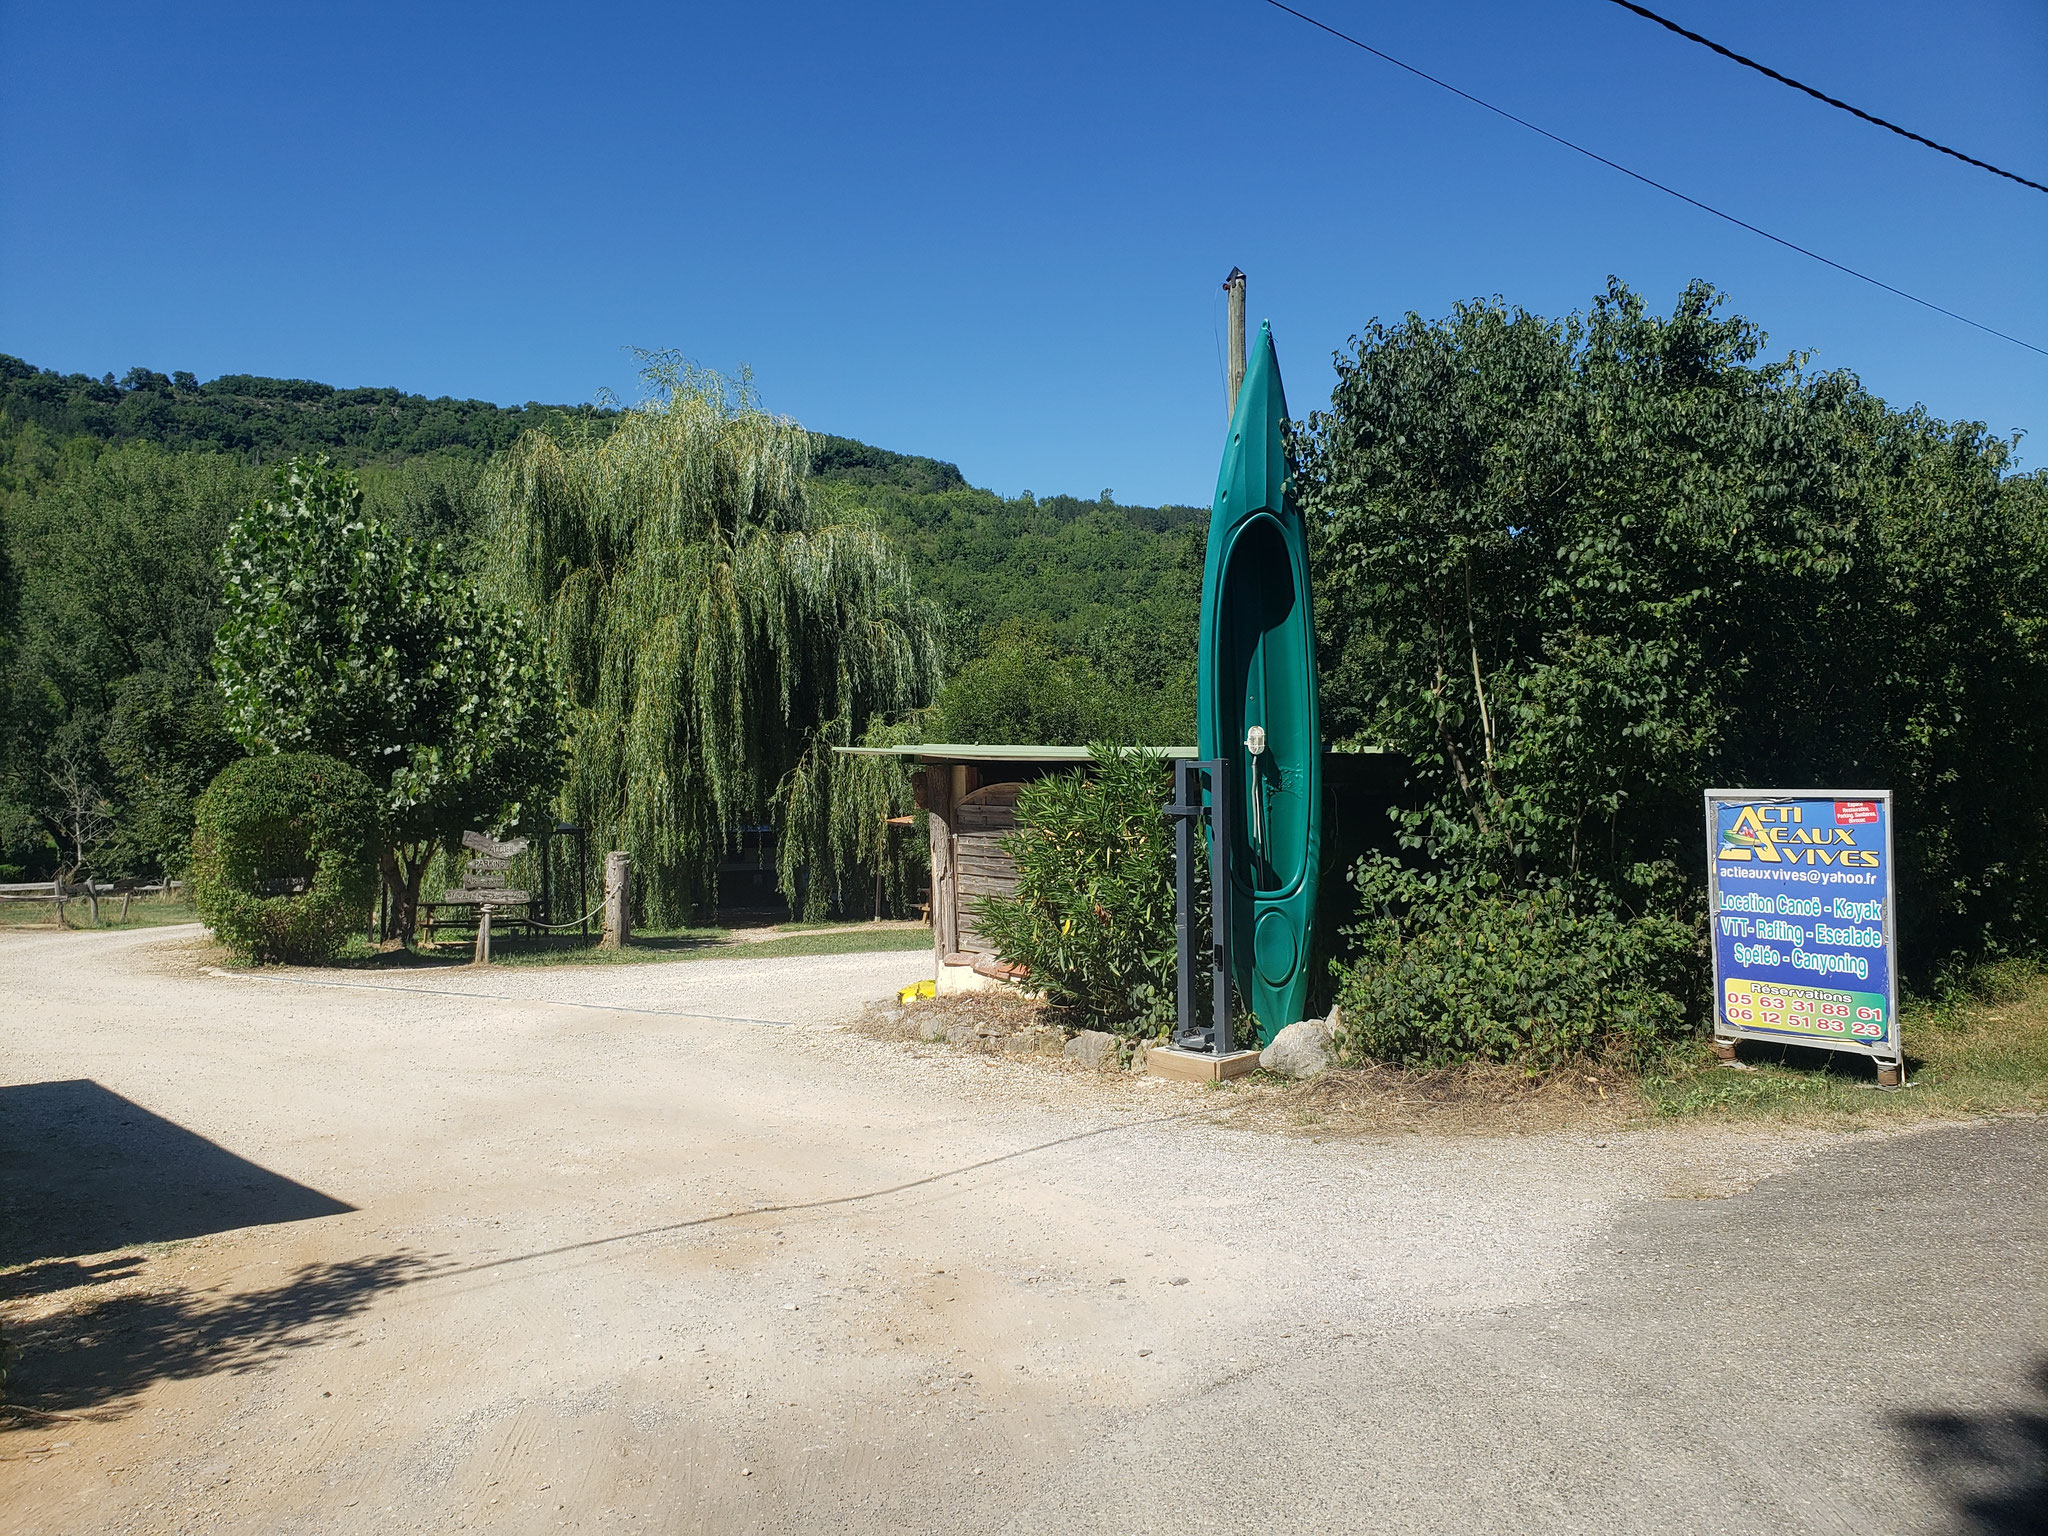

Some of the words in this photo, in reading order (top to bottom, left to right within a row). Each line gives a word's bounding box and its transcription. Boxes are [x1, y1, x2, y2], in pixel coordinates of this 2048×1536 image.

[1769, 827, 1857, 846] EAUX
[475, 860, 505, 868] PARKING
[1781, 848, 1880, 868] VIVES
[1720, 867, 1877, 885] actieauxvives@yahoo.fr
[1719, 891, 1775, 912] Location
[1776, 894, 1822, 916] Canoë
[1833, 898, 1882, 924] Kayak
[1756, 919, 1804, 946] Rafting
[1815, 923, 1882, 947] Escalade
[1734, 943, 1780, 968] Spéléo
[1792, 949, 1868, 979] Canyoning
[1750, 983, 1853, 1003] Réservations
[1727, 992, 1752, 1005] 05
[1759, 996, 1785, 1009] 63
[1792, 1000, 1815, 1013] 31
[1822, 1003, 1849, 1017] 88
[1857, 1007, 1882, 1021] 61
[1728, 1007, 1753, 1020] 06
[1761, 1011, 1780, 1024] 12
[1788, 1015, 1810, 1028] 51
[1816, 1018, 1844, 1032] 83
[1852, 1022, 1881, 1036] 23
